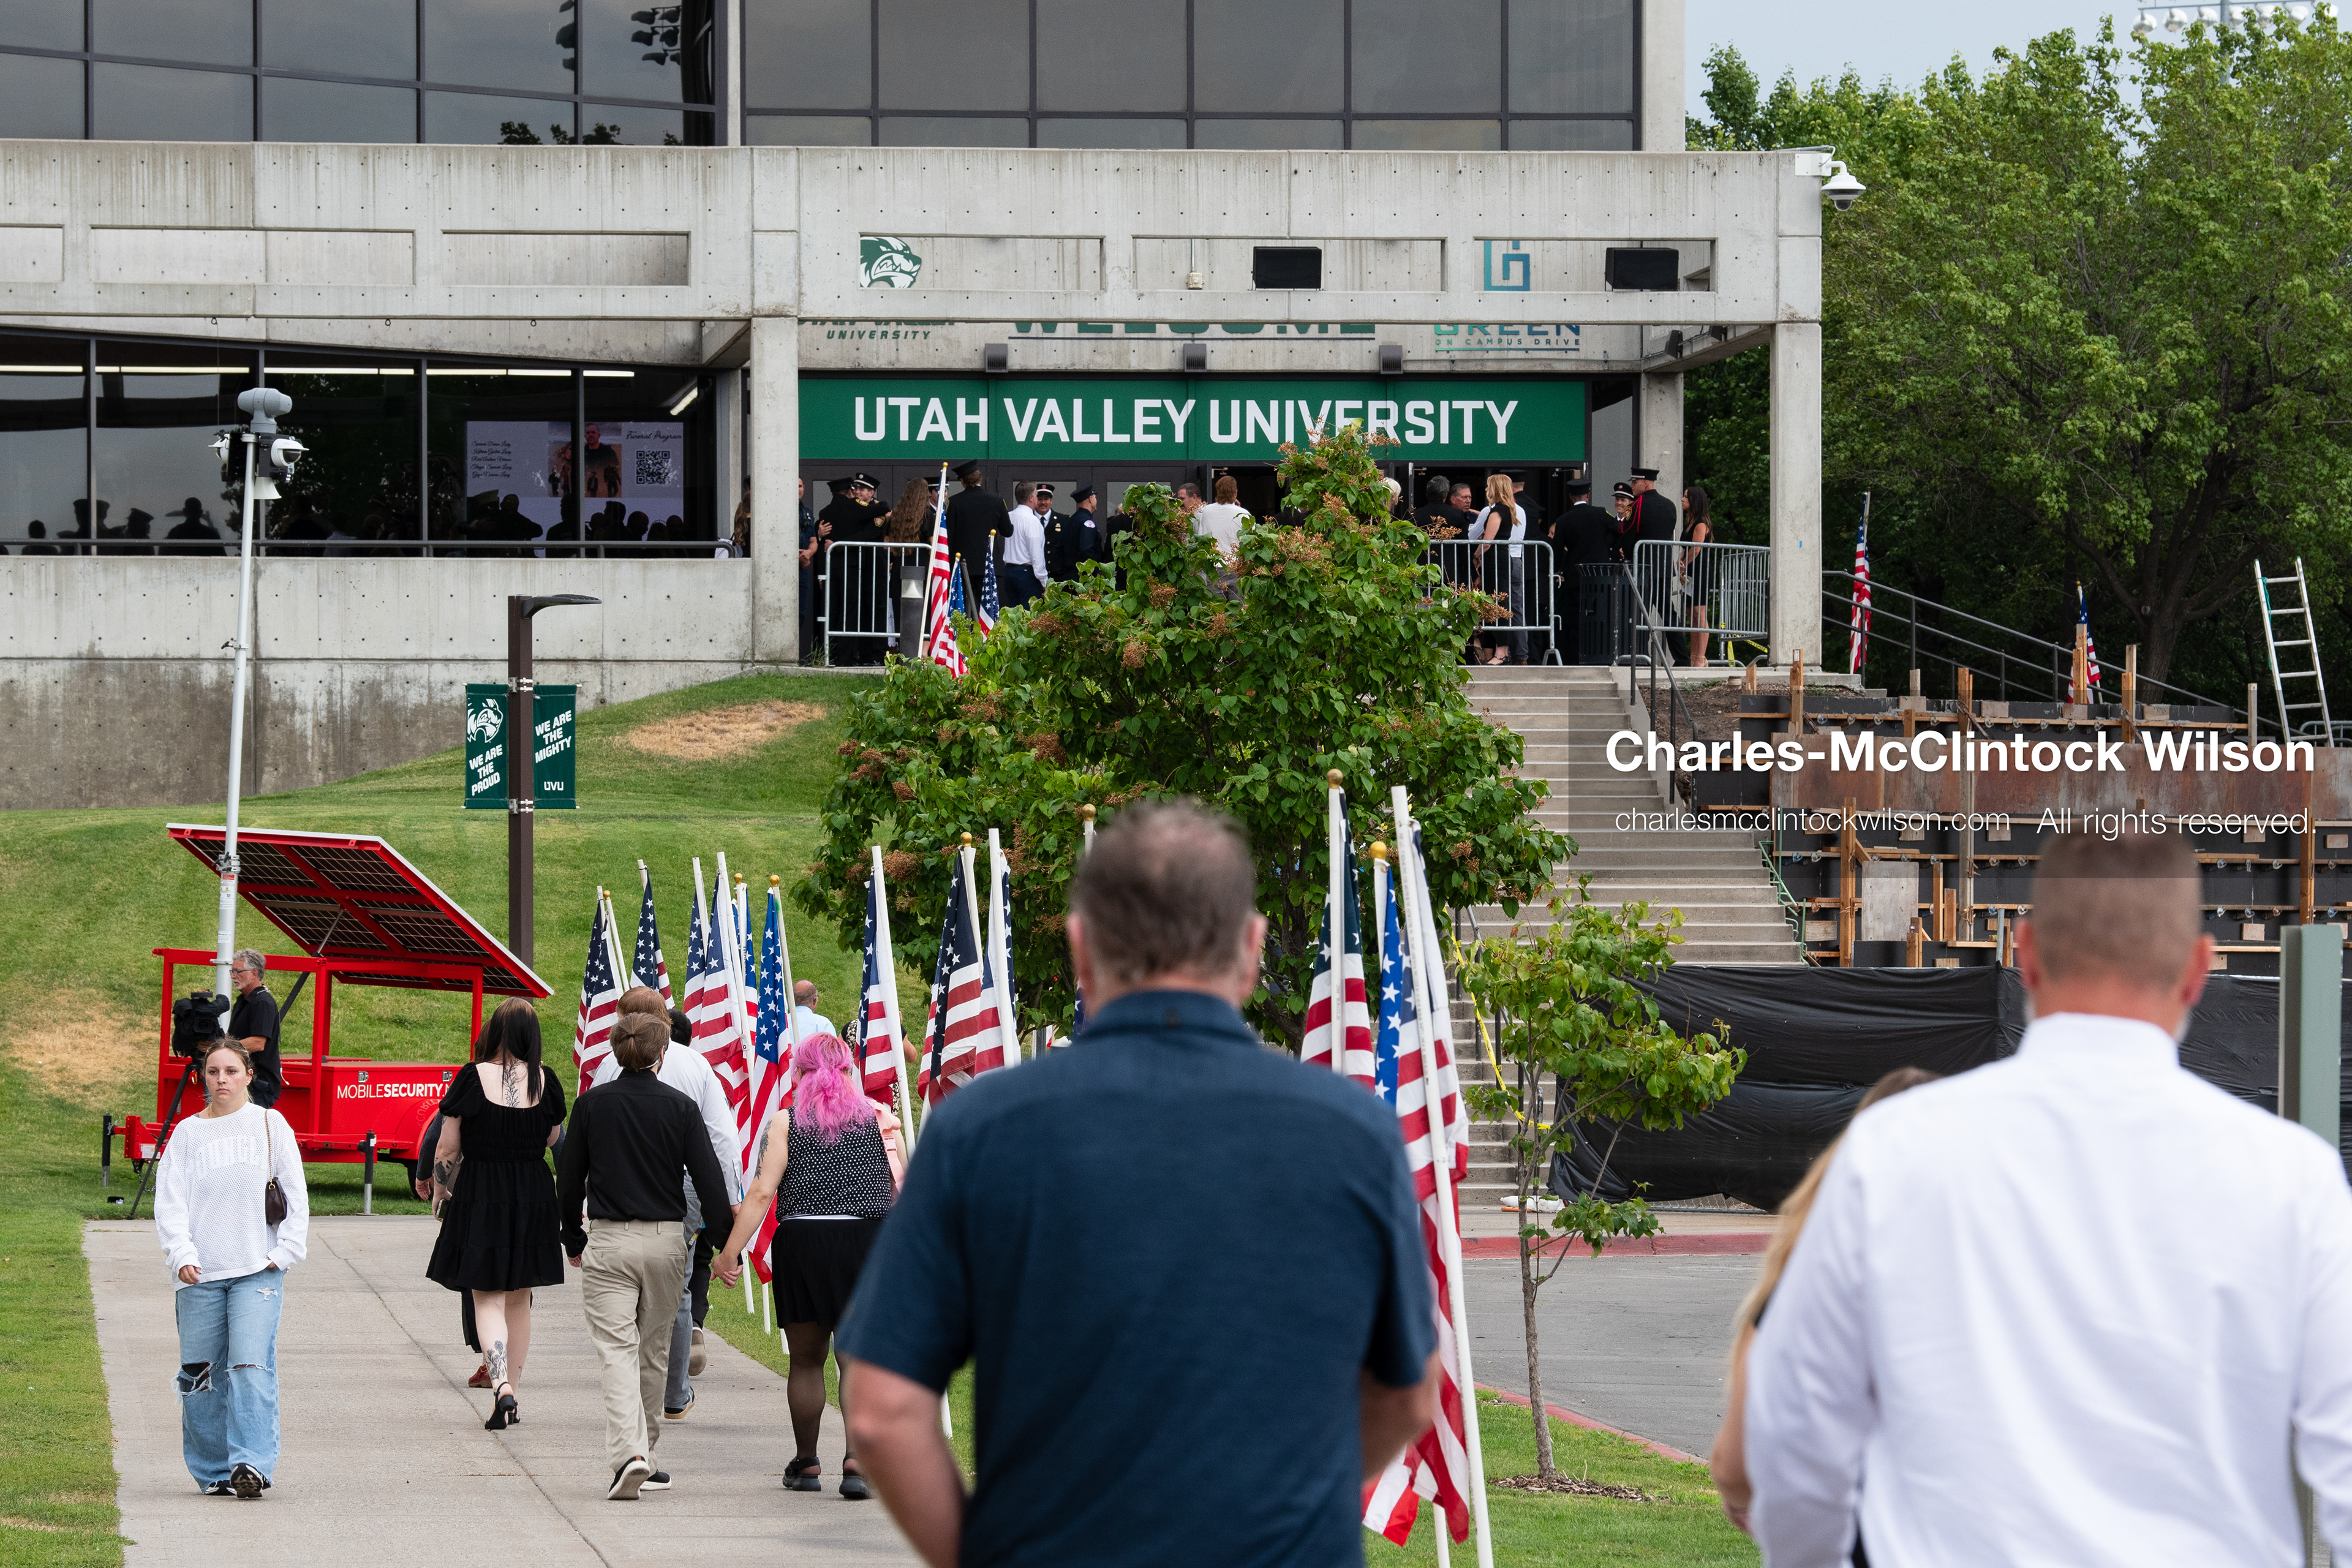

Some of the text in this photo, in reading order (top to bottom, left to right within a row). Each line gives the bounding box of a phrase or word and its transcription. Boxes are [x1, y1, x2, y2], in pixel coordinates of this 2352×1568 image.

[827, 330, 931, 339] UNIVERSITY
[855, 397, 1518, 444] UTAH VALLEY UNIVERSITY
[626, 431, 682, 442] Funeral Program
[535, 710, 572, 736] WE ARE
[543, 727, 563, 745] THE
[469, 744, 503, 770] WE ARE
[535, 736, 571, 763] MIGHTY
[477, 761, 494, 779] THE
[472, 772, 500, 796] PROUD
[544, 782, 564, 791] UVU
